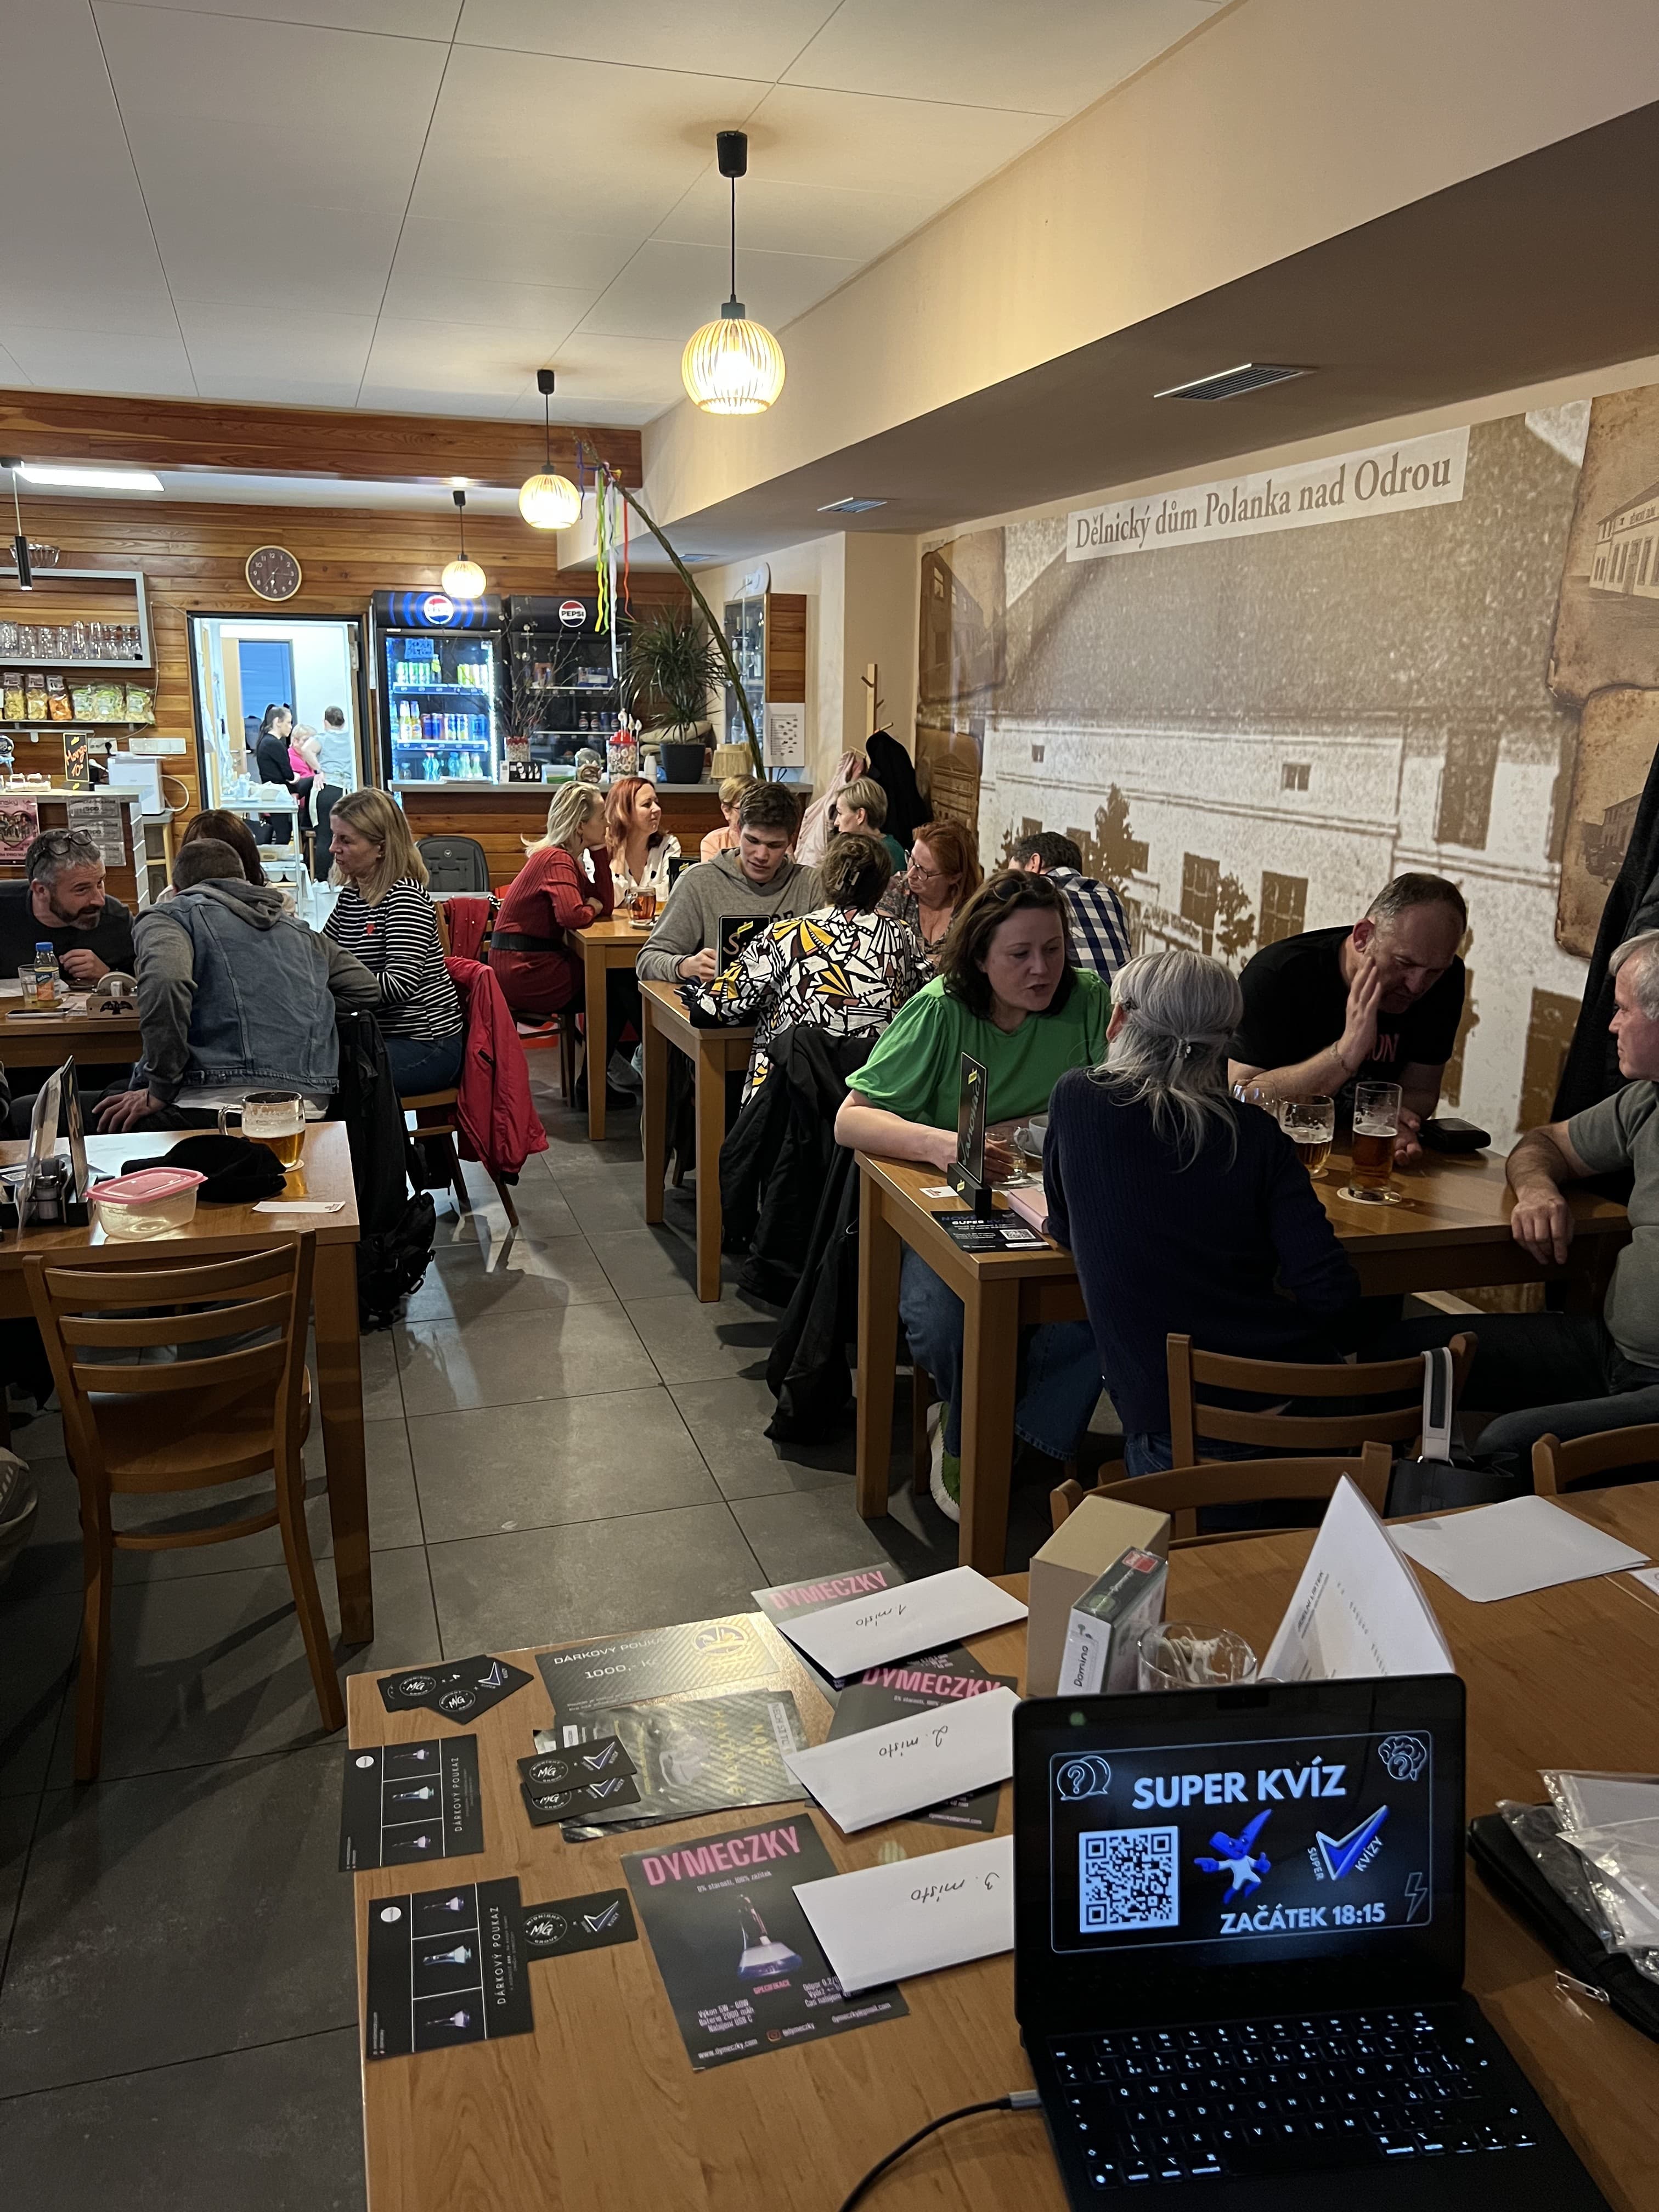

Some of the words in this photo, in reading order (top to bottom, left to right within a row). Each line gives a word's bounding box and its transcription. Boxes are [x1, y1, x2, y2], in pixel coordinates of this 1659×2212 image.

[1075, 505, 1151, 549] Dělnický
[1155, 499, 1198, 535] dům
[1204, 479, 1291, 528] Polanka
[1297, 464, 1346, 510] nad
[1354, 452, 1451, 501] Odrou
[65, 744, 87, 766] Mango
[769, 1571, 888, 1610] DYMECZKY
[1073, 1645, 1088, 1688] Domino
[451, 1757, 460, 1788] POUKAZ
[1132, 1771, 1249, 1810] SUPER
[1257, 1756, 1346, 1801] KVÍZ
[642, 1825, 800, 1886] DYMECZKY
[1307, 1847, 1324, 1881] SUPER
[1354, 1836, 1385, 1872] KVÍZY
[697, 1884, 707, 1893] 0%
[911, 1879, 965, 1903] místo
[490, 1906, 503, 1948] POUKAZ
[1220, 1904, 1328, 1934] ZAČÁTEK
[1332, 1903, 1386, 1926] 18:15
[492, 1953, 506, 2005] DÁRKOVÝ
[723, 2009, 739, 2021] 2000
[740, 2006, 755, 2016] mAh
[735, 2016, 747, 2026] USB
[697, 2038, 758, 2059] www.dymeczky.com
